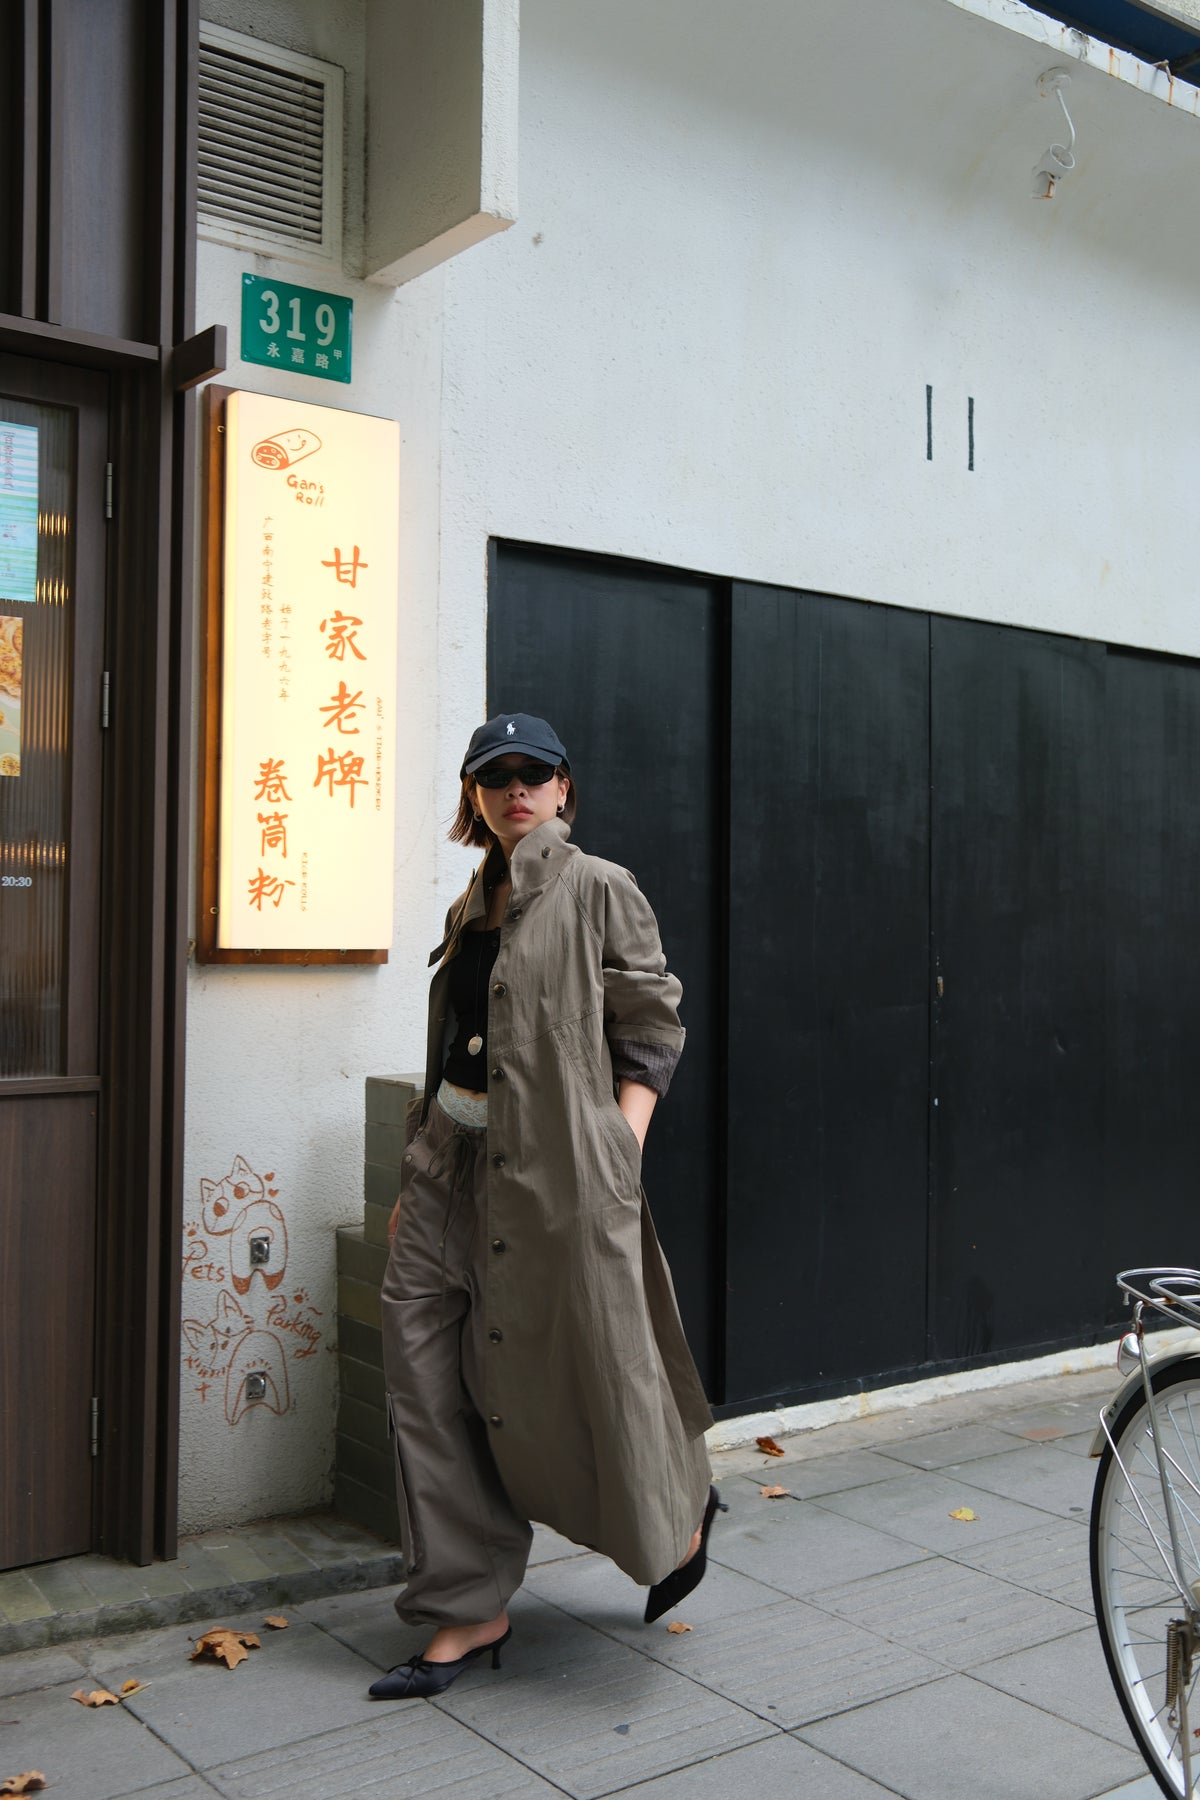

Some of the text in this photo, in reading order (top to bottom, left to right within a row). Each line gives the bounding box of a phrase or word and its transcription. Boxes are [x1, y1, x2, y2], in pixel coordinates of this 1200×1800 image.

[259, 290, 336, 347] 319
[266, 342, 330, 370] 永嘉路
[296, 491, 325, 508] Roll
[313, 545, 369, 809] 甘家老牌
[247, 757, 296, 912] 卷筒粉
[1, 876, 33, 887] 20:30
[182, 1240, 226, 1282] Pets
[267, 1295, 323, 1358] Parking
